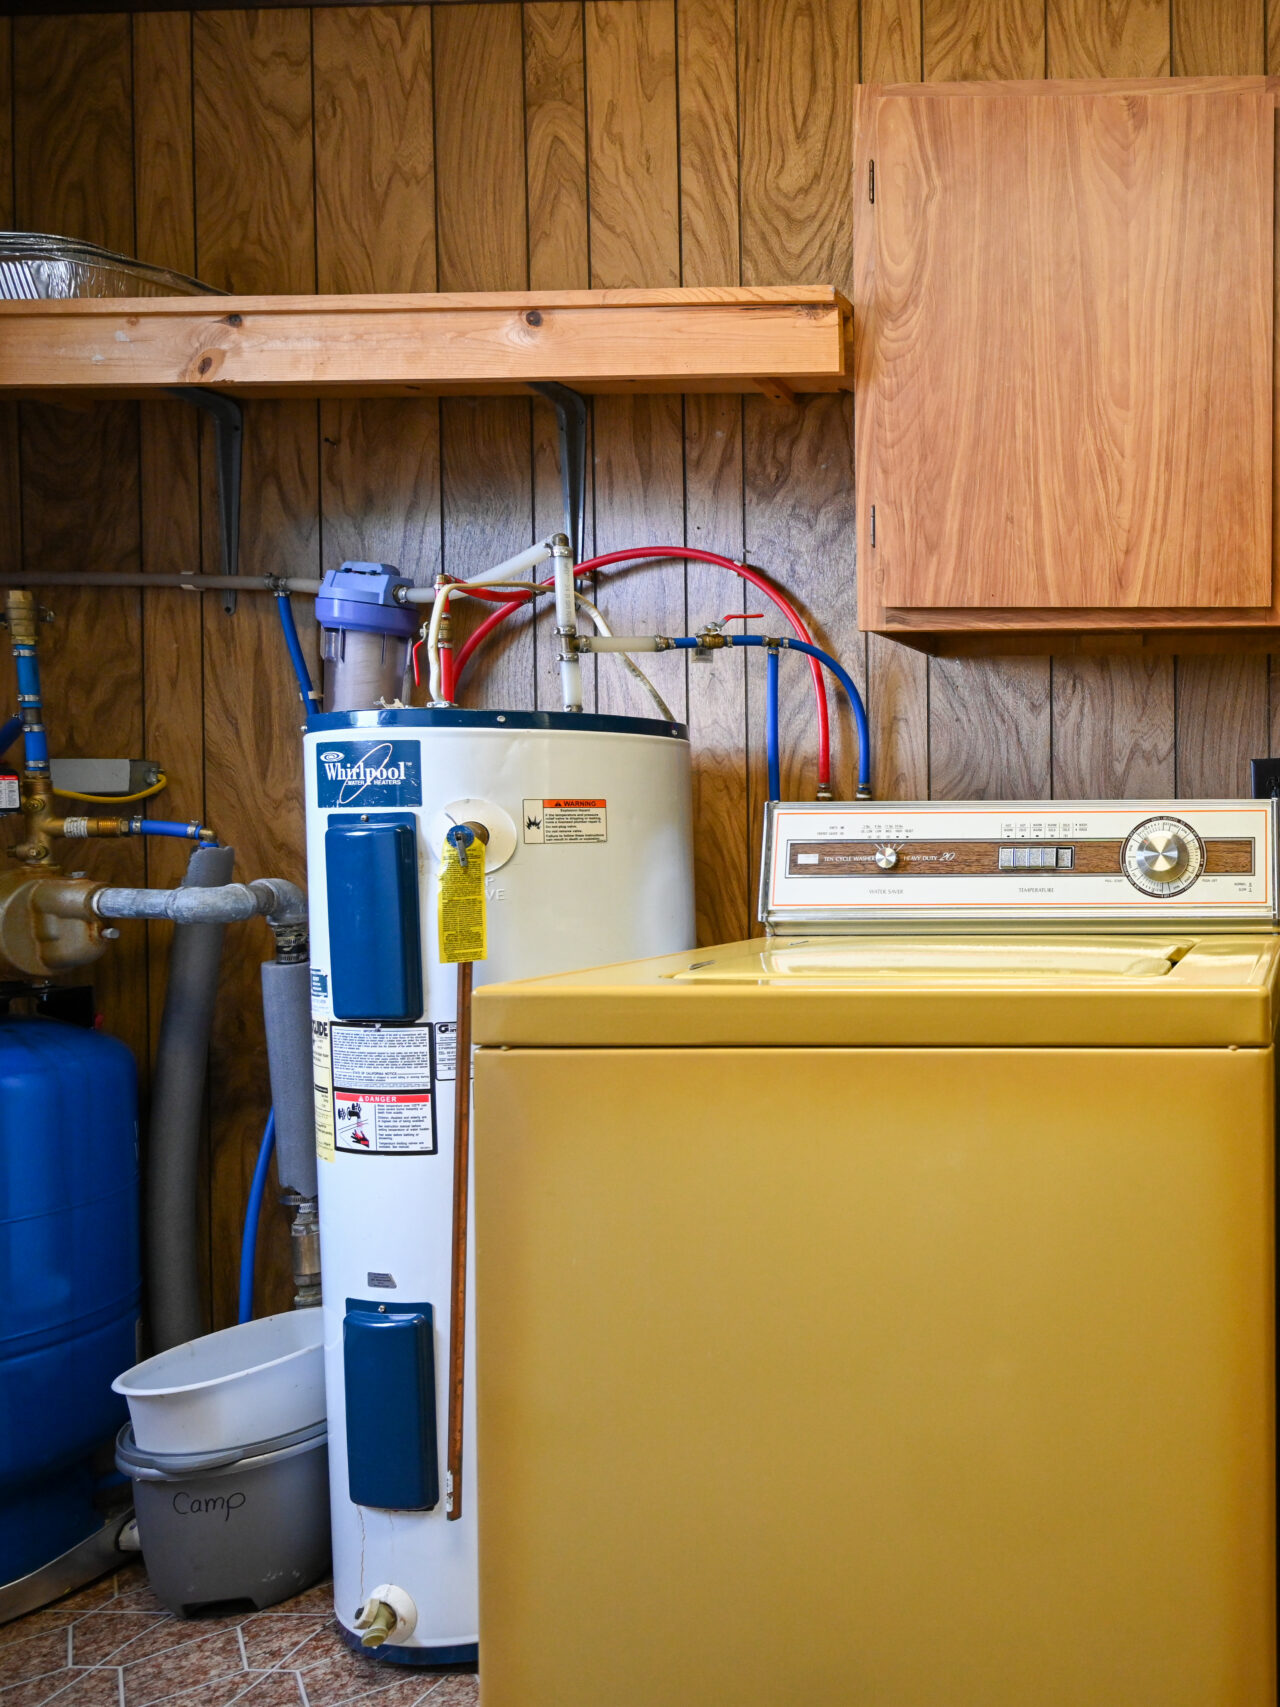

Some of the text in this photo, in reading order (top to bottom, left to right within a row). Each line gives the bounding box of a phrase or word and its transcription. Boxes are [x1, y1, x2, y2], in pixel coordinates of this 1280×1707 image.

[324, 762, 406, 786] Whirlpool
[312, 1020, 329, 1037] UIDE
[364, 1095, 398, 1103] DANGER
[172, 1491, 247, 1521] Camp
